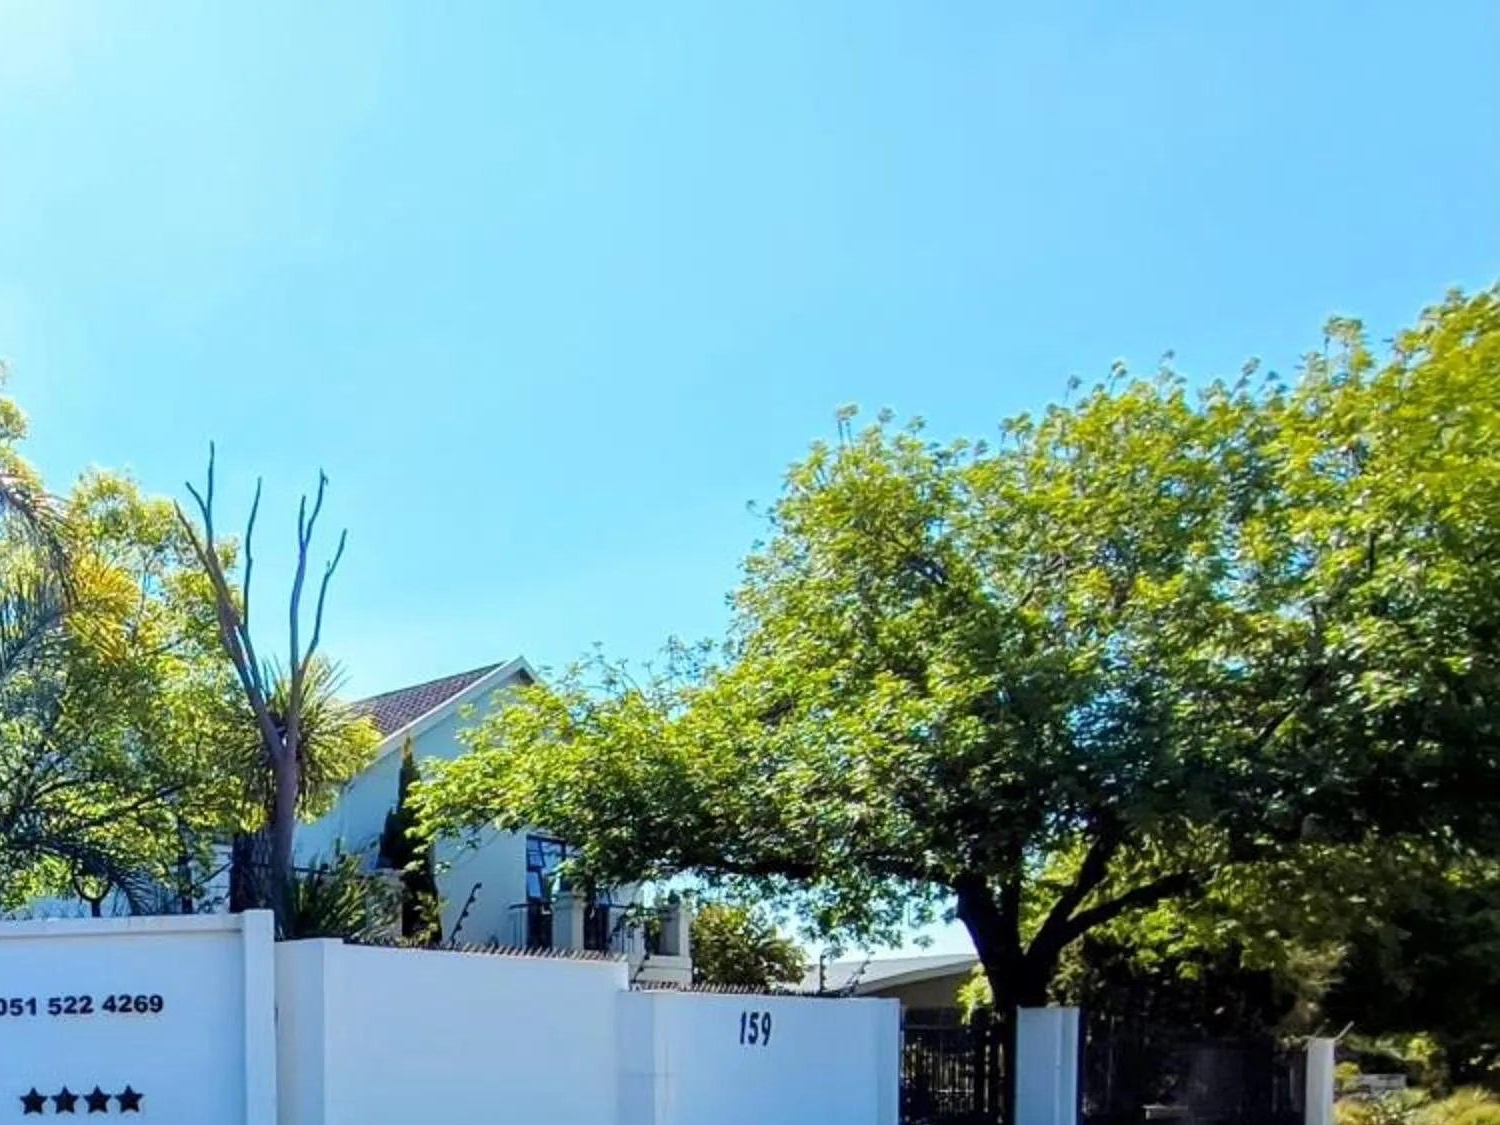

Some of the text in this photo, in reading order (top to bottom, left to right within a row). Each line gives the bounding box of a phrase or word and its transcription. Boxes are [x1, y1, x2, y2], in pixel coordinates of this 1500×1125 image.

[47, 995, 95, 1017] 522
[101, 993, 165, 1015] 4269
[738, 1010, 773, 1047] 159
